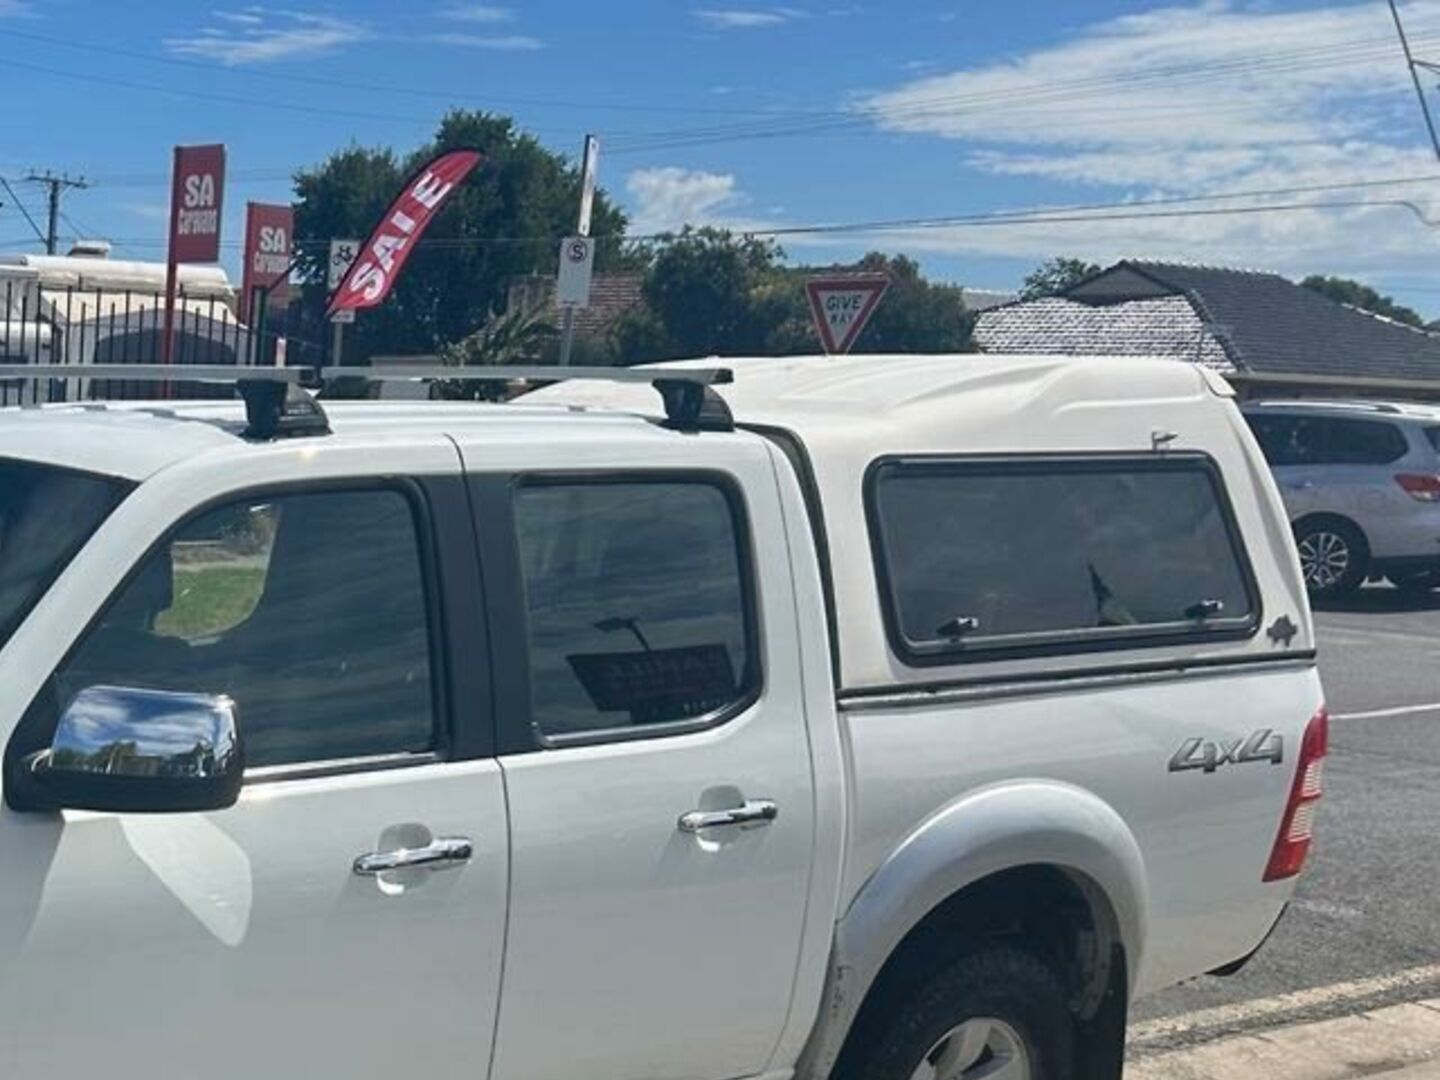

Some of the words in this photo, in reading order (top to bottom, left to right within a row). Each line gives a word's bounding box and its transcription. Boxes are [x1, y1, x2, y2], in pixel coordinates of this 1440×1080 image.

[185, 173, 215, 208] SA
[260, 226, 286, 253] SA
[826, 294, 862, 311] GIVE
[1168, 728, 1283, 774] 4x4
